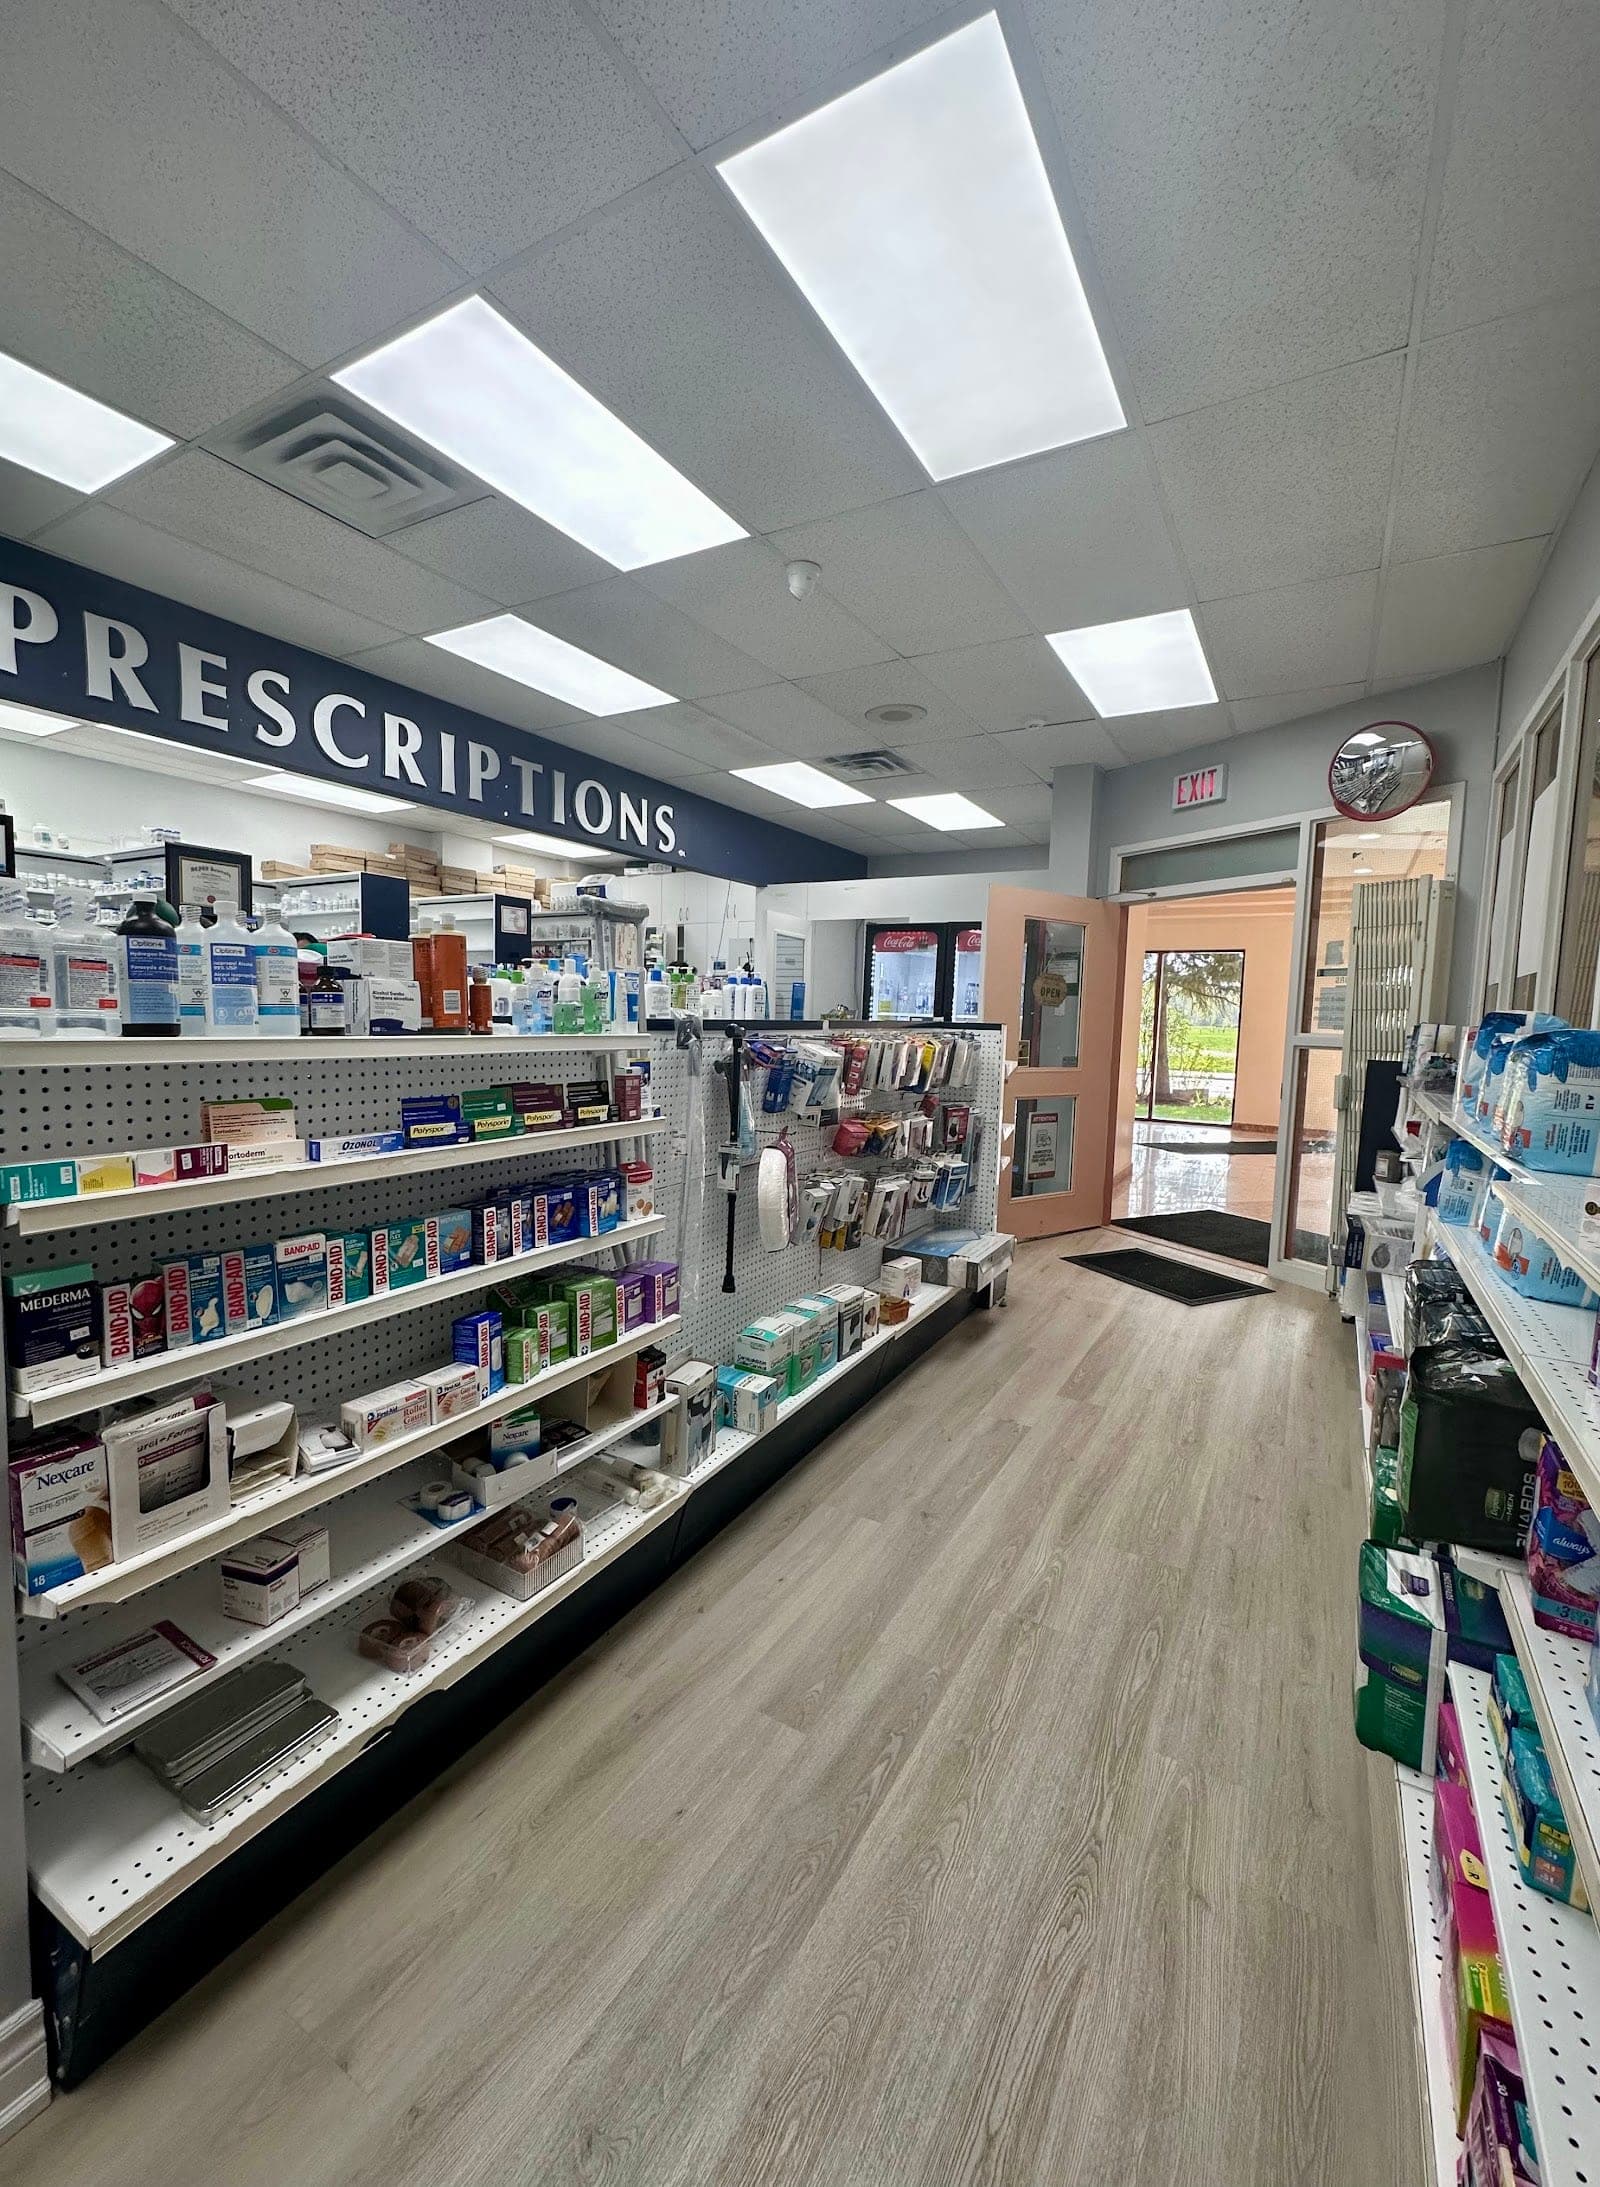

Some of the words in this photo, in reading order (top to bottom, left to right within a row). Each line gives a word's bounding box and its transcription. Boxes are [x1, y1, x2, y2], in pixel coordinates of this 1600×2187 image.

[0, 582, 676, 853] PRESCRIPTIONS
[1178, 769, 1216, 804] EXIT
[1040, 986, 1061, 998] OPEN
[413, 1126, 446, 1135] Polyspor
[477, 1118, 510, 1129] Polysporin
[526, 1113, 553, 1123] Polyspor
[229, 1149, 266, 1160] ortoderm
[342, 1139, 377, 1151] OZONOL
[537, 1197, 547, 1242] BAND-AID
[427, 1220, 438, 1272] BAND-AID
[486, 1210, 496, 1257] BAND-AID
[284, 1242, 320, 1257] BAND-AID
[374, 1233, 388, 1286] BAND-AID
[329, 1245, 343, 1301] BAND-AID
[20, 1288, 91, 1313] MEDERMA
[168, 1268, 189, 1332] BAND-AID
[225, 1257, 245, 1320] BAND-AID
[109, 1290, 130, 1358] BAND-AID
[580, 1293, 591, 1343] BAND-AID
[481, 1327, 489, 1368] BAND-AID
[539, 1313, 548, 1355] BAND-AID
[403, 1402, 428, 1417] Rolled
[403, 1411, 428, 1425] Gauze
[137, 1421, 203, 1452] urgi-Forme
[502, 1430, 529, 1441] Nexcare
[24, 1470, 37, 1478] 3M
[37, 1460, 96, 1490] Nexcare
[1506, 1493, 1515, 1516] MEN
[1552, 1537, 1591, 1555] always
[33, 1575, 46, 1587] 18
